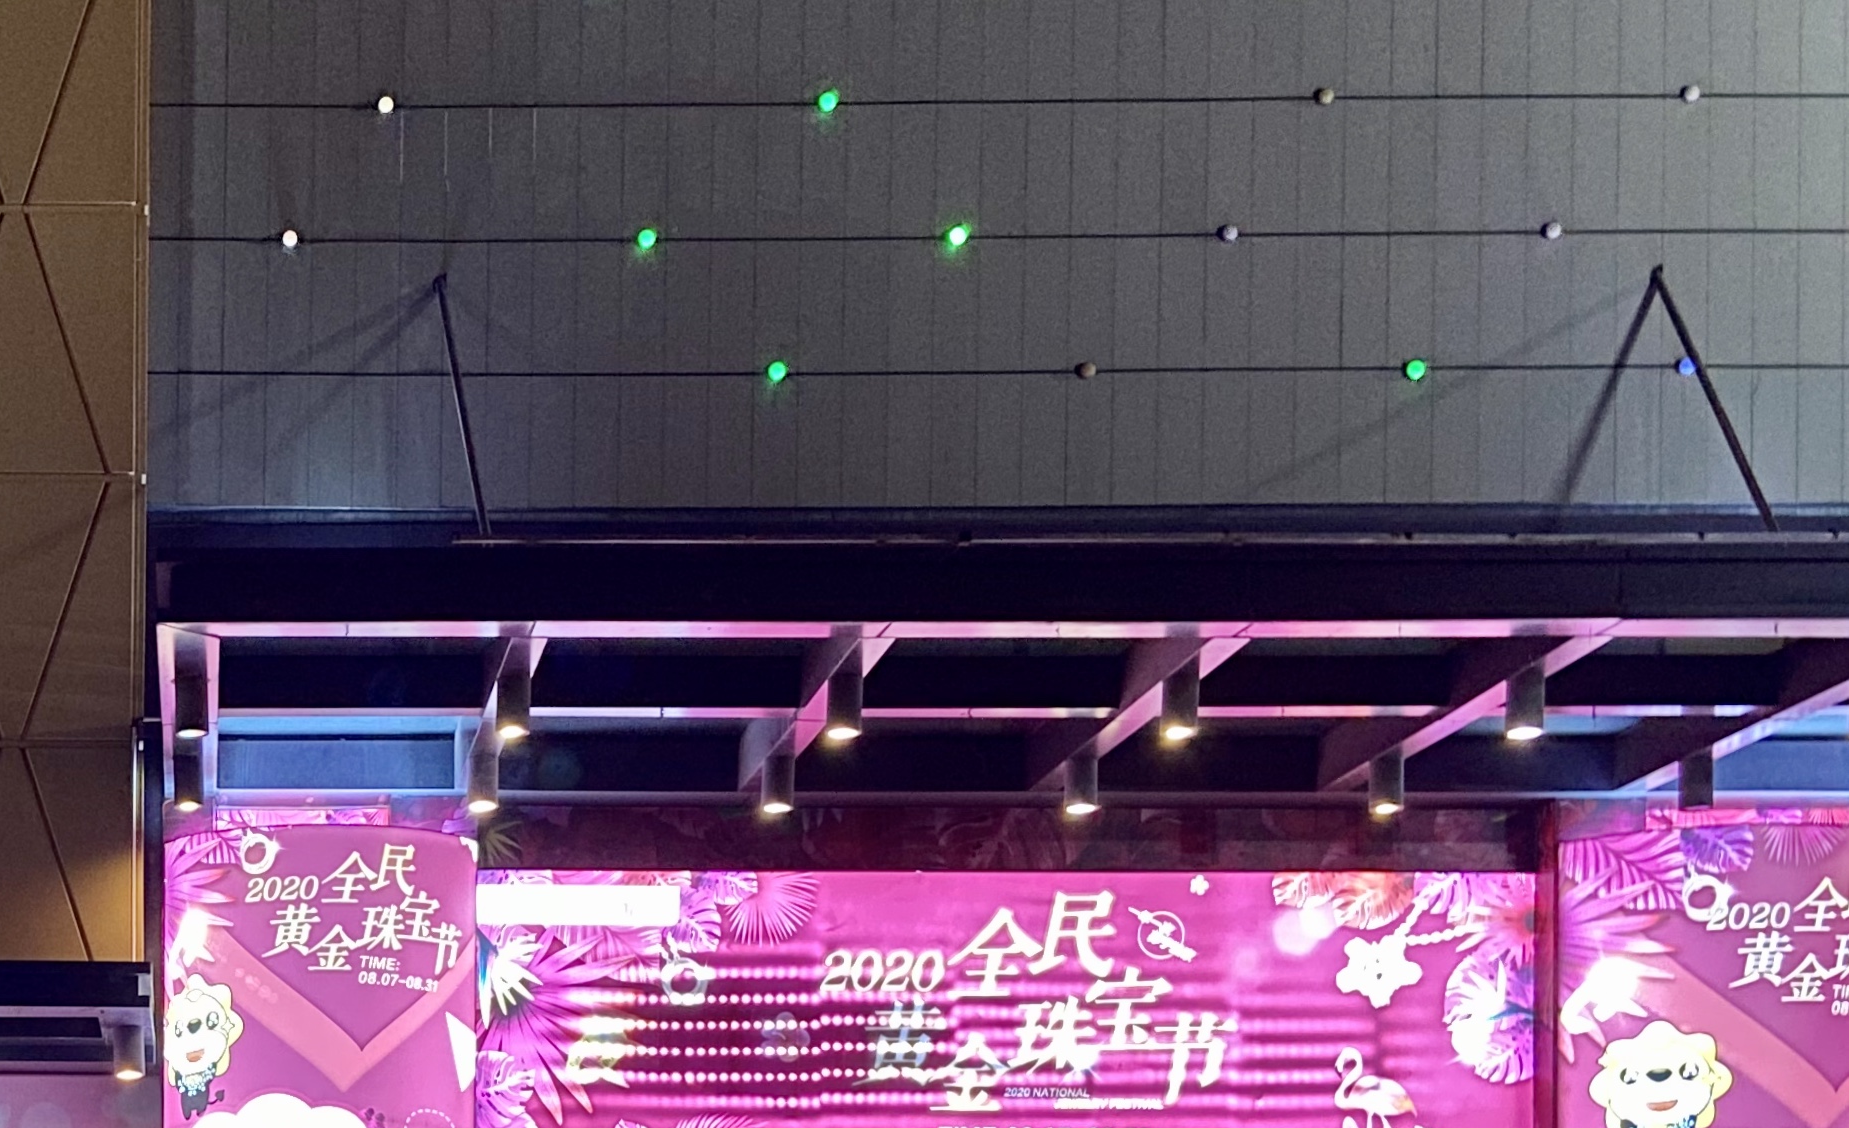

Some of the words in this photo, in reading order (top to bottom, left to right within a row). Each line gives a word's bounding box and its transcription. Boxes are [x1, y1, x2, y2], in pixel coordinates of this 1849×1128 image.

[245, 876, 319, 903] 2020
[321, 843, 416, 904] 全民
[1706, 901, 1792, 931] 2020
[1794, 876, 1849, 933] 全
[261, 891, 463, 976] 黄金珠宝节
[820, 949, 946, 993] 2020
[947, 889, 1118, 999] 全民
[357, 971, 439, 993] 08.07-08.31
[359, 955, 401, 972] TIME:
[1032, 1087, 1091, 1098] NATIONAL
